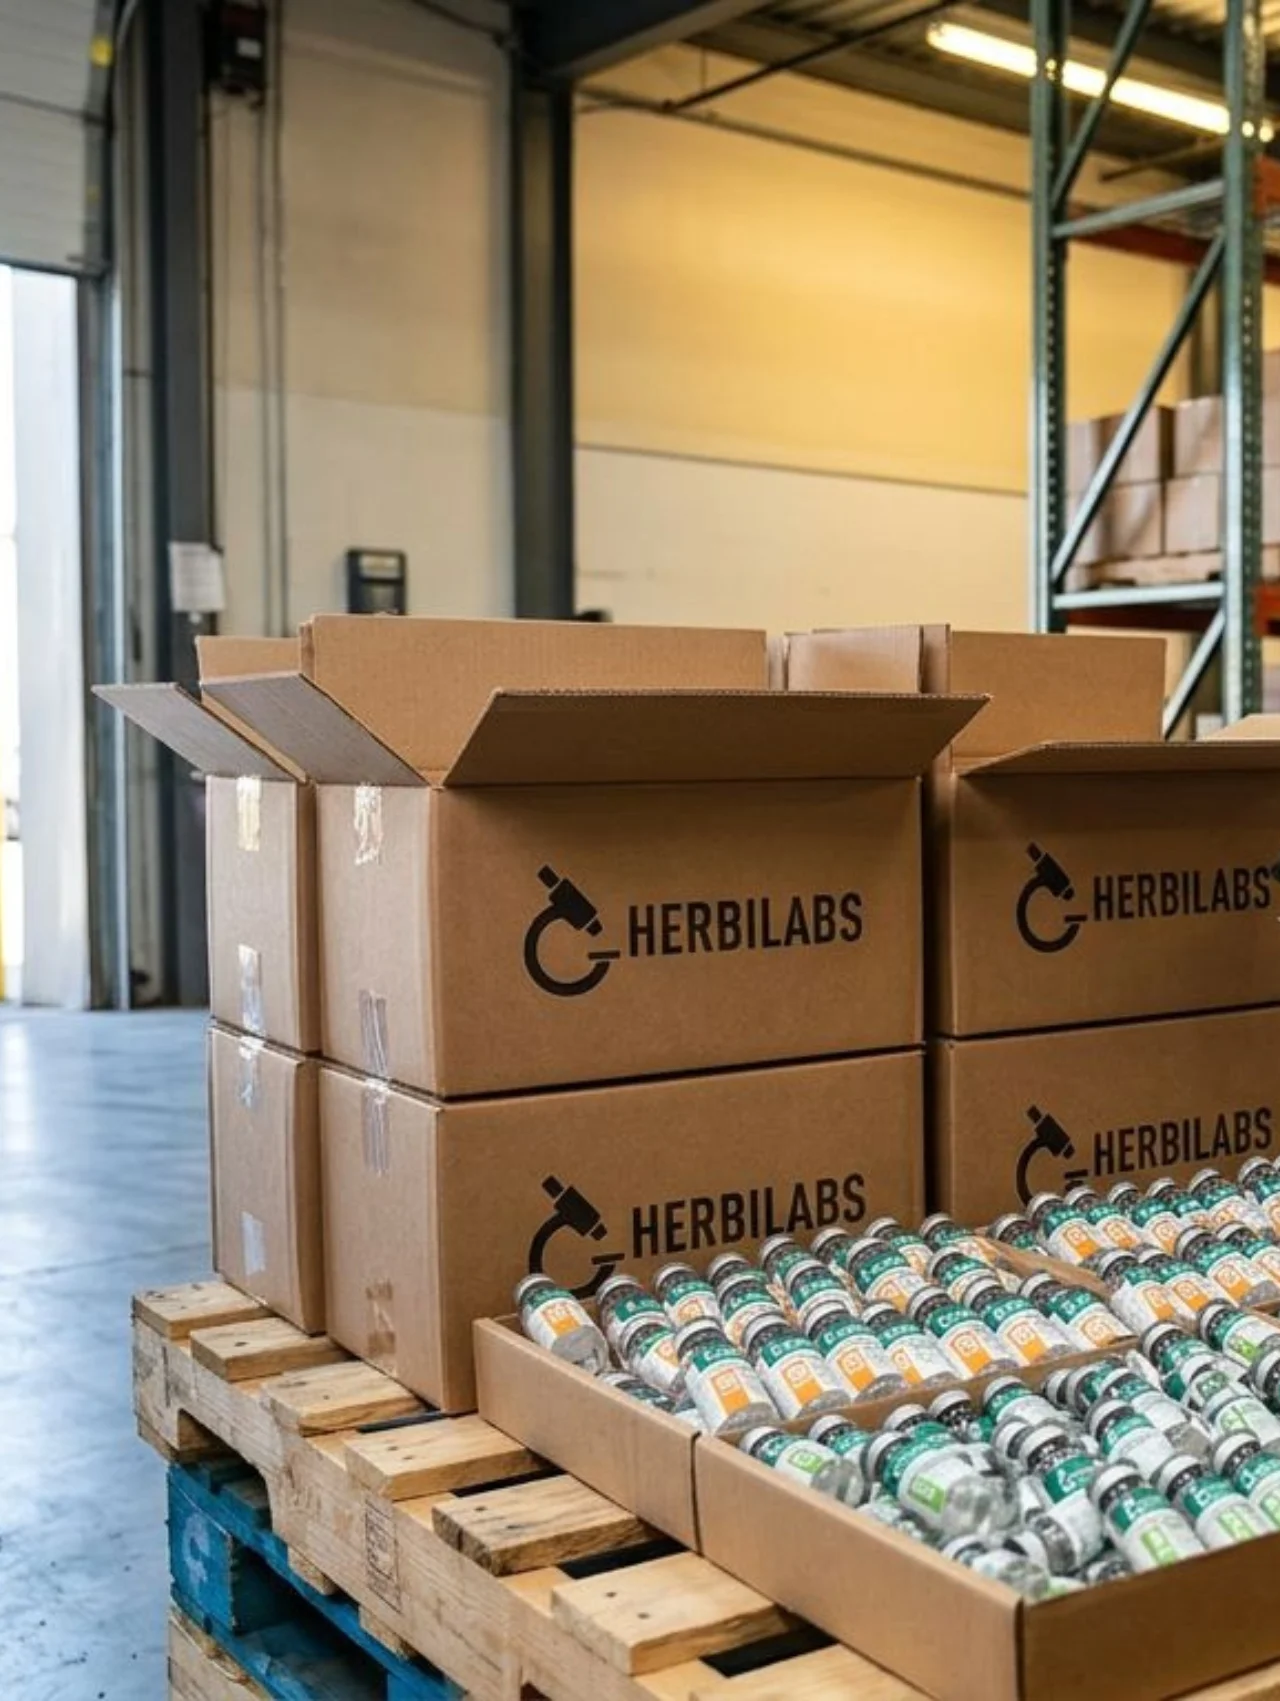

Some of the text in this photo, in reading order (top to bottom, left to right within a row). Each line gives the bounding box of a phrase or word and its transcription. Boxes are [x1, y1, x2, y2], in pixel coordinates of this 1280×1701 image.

[630, 893, 862, 957] HERBILABS
[1094, 867, 1271, 922] HERBILABS
[1095, 1107, 1271, 1177] HERBILABS
[632, 1174, 866, 1260] HERBILABS
